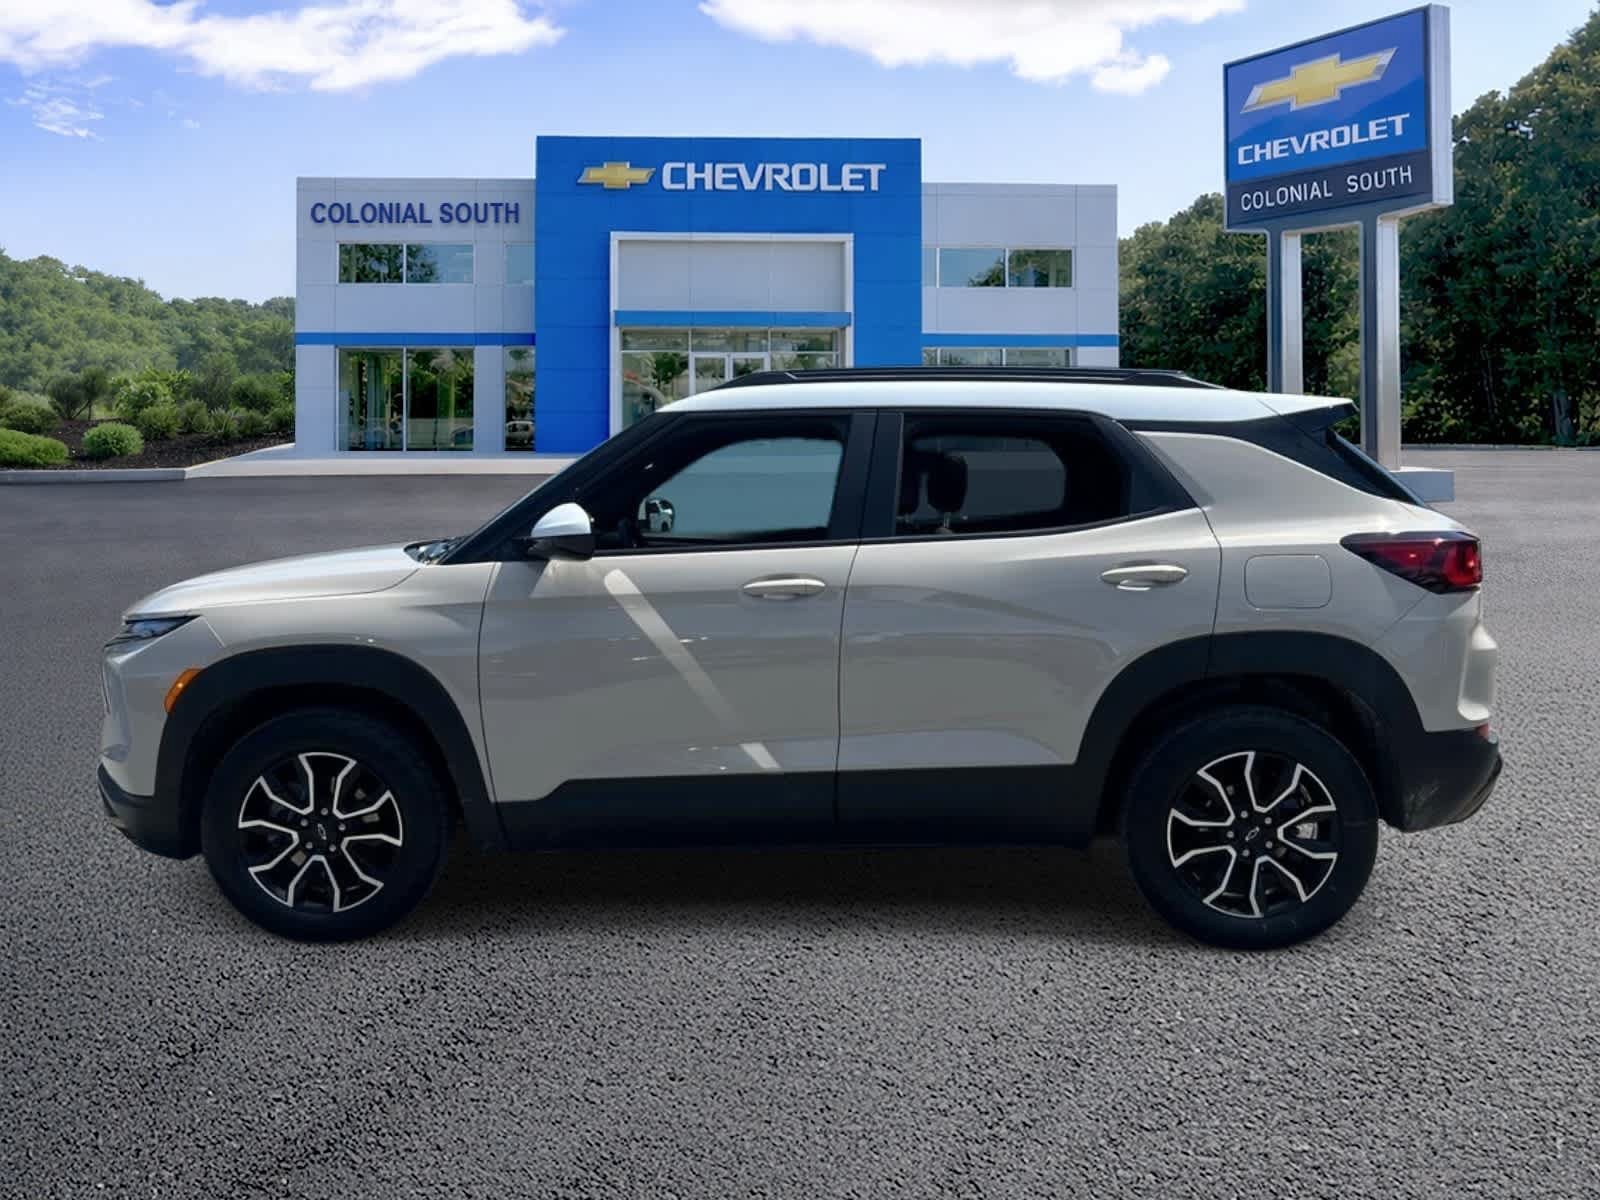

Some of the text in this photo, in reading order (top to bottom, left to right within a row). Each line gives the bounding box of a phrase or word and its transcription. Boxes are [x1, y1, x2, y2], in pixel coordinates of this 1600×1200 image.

[1238, 113, 1410, 165] CHEVROLET
[661, 162, 887, 192] CHEVROLET
[1241, 165, 1413, 211] COLONIAL SOUTH
[310, 202, 520, 224] COLONIAL SOUTH
